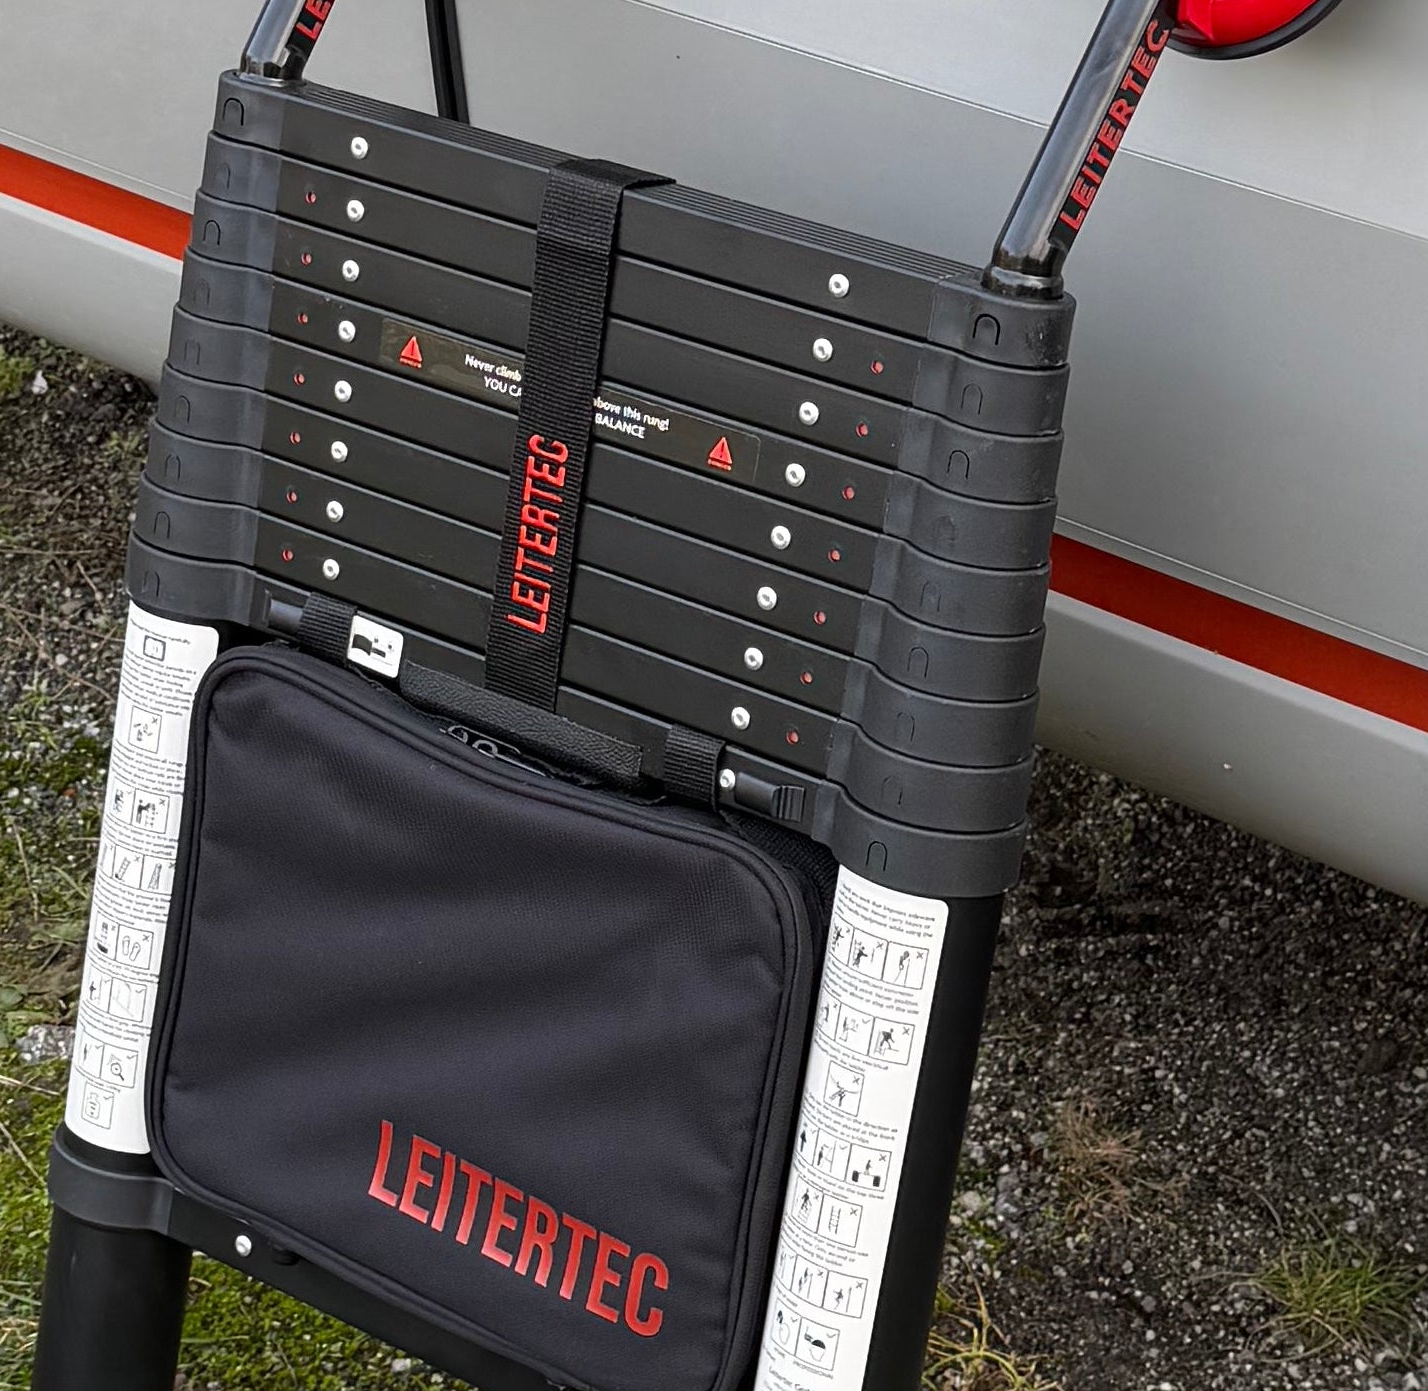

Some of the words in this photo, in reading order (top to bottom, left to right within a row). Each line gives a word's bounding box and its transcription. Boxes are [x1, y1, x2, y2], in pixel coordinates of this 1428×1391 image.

[1060, 18, 1171, 232] LEITERTEC
[465, 353, 495, 374] Never
[495, 365, 522, 383] climb
[623, 405, 641, 421] this
[484, 375, 508, 394] YOU
[594, 412, 646, 439] BALANCE
[507, 433, 570, 635] LEITERTEC
[368, 1119, 669, 1337] LEITERTEC
